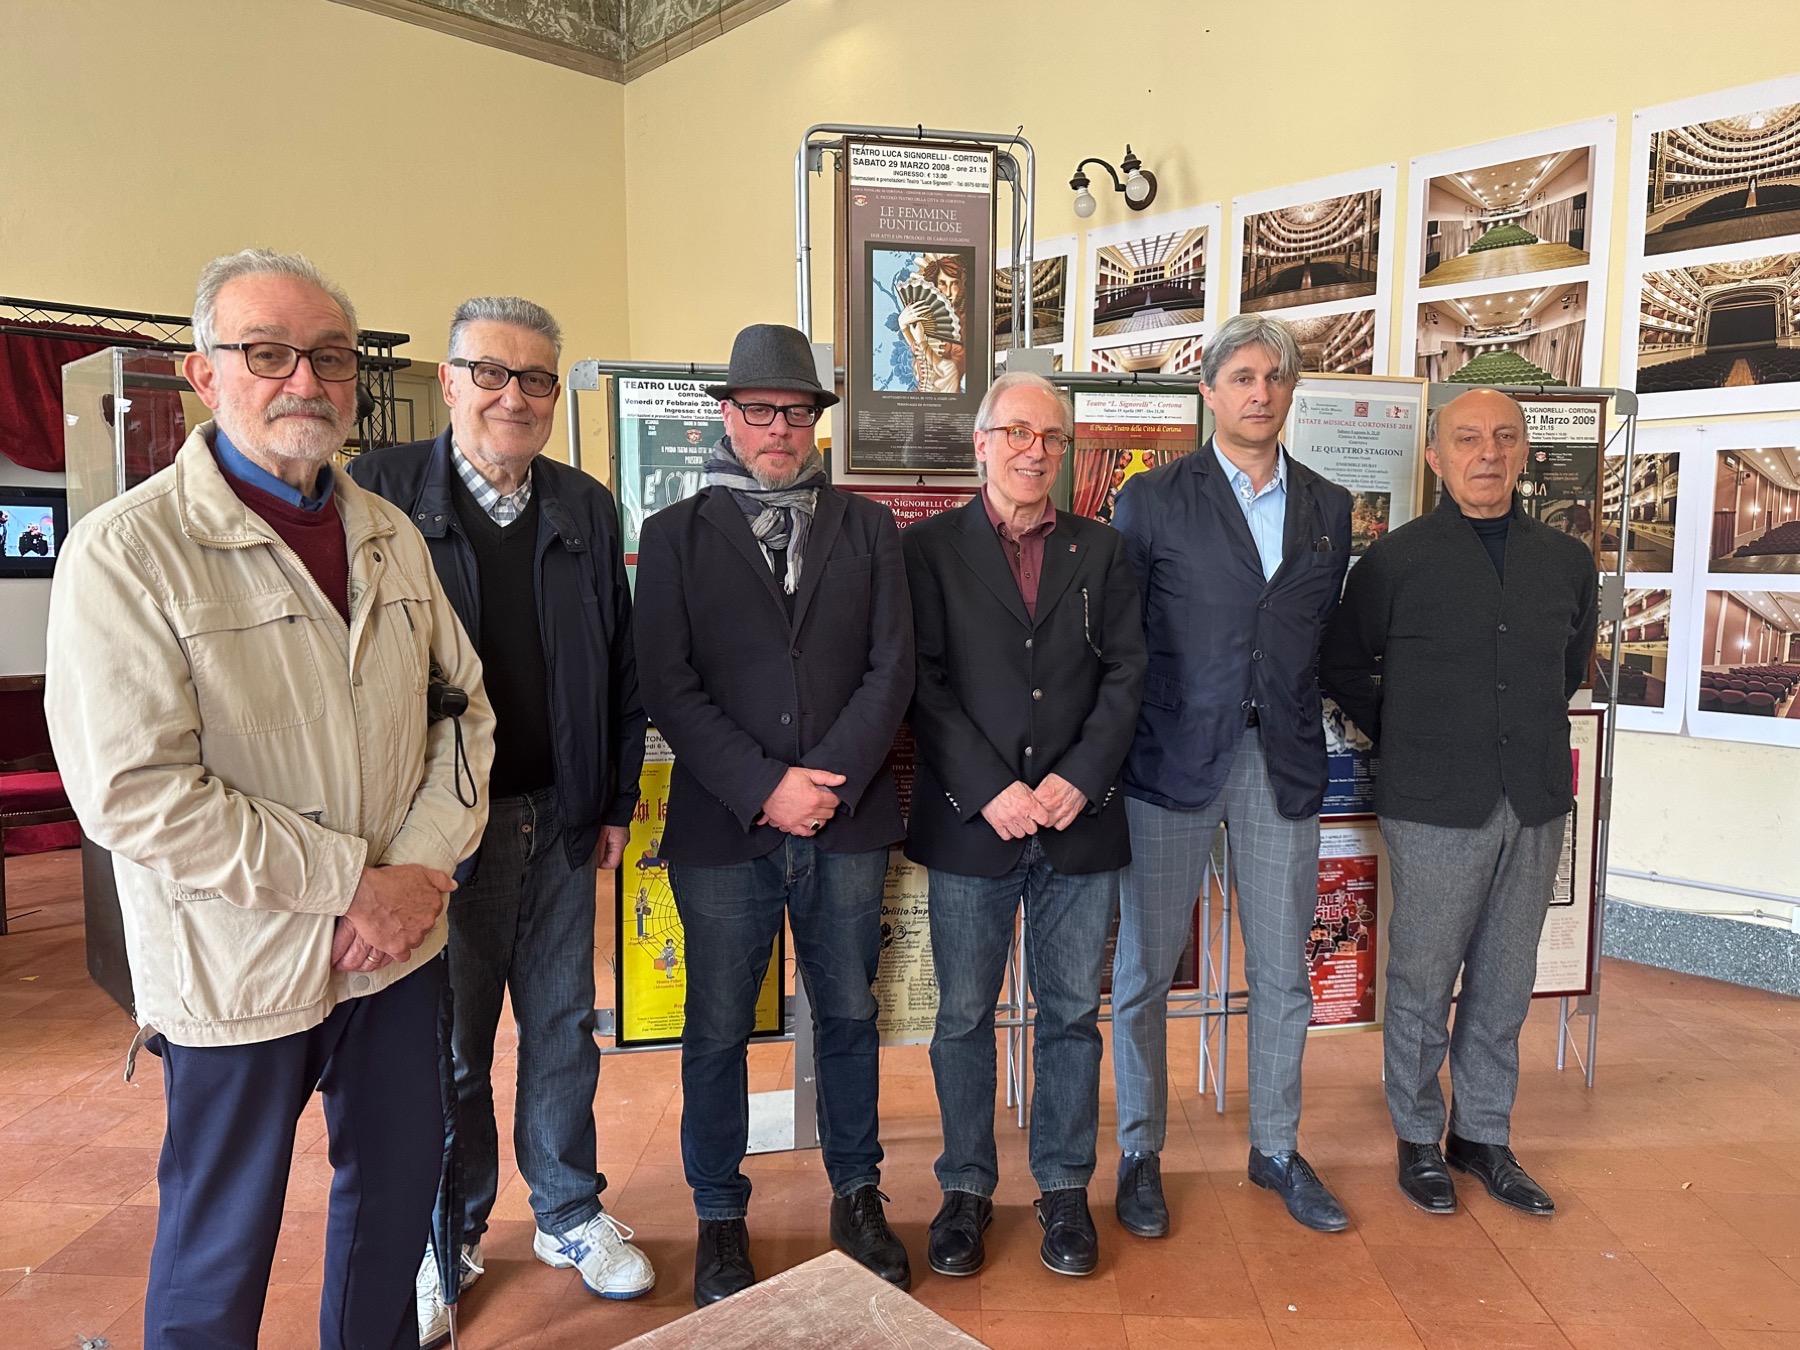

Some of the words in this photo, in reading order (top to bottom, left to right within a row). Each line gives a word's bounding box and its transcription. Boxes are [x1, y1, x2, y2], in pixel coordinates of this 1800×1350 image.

[851, 148, 880, 156] TEATRO
[904, 151, 947, 161] SIGNORELLI
[952, 154, 988, 163] CORTONA
[852, 158, 886, 167] SABATO
[900, 161, 930, 170] MARZO
[932, 163, 950, 171] 2008
[880, 206, 894, 217] LE
[898, 206, 957, 220] FEMMINE
[879, 218, 962, 233] PUNTIGLIOSE
[624, 381, 665, 390] TEATRO
[668, 382, 696, 391] LUCA
[1526, 415, 1536, 424] 21
[1540, 415, 1569, 424] Marzo
[1572, 416, 1595, 425] 2009
[1324, 446, 1363, 454] QUATTRO
[1365, 448, 1403, 456] STAGIONI
[894, 498, 942, 508] SIGNORELLI
[892, 508, 923, 518] Maggio
